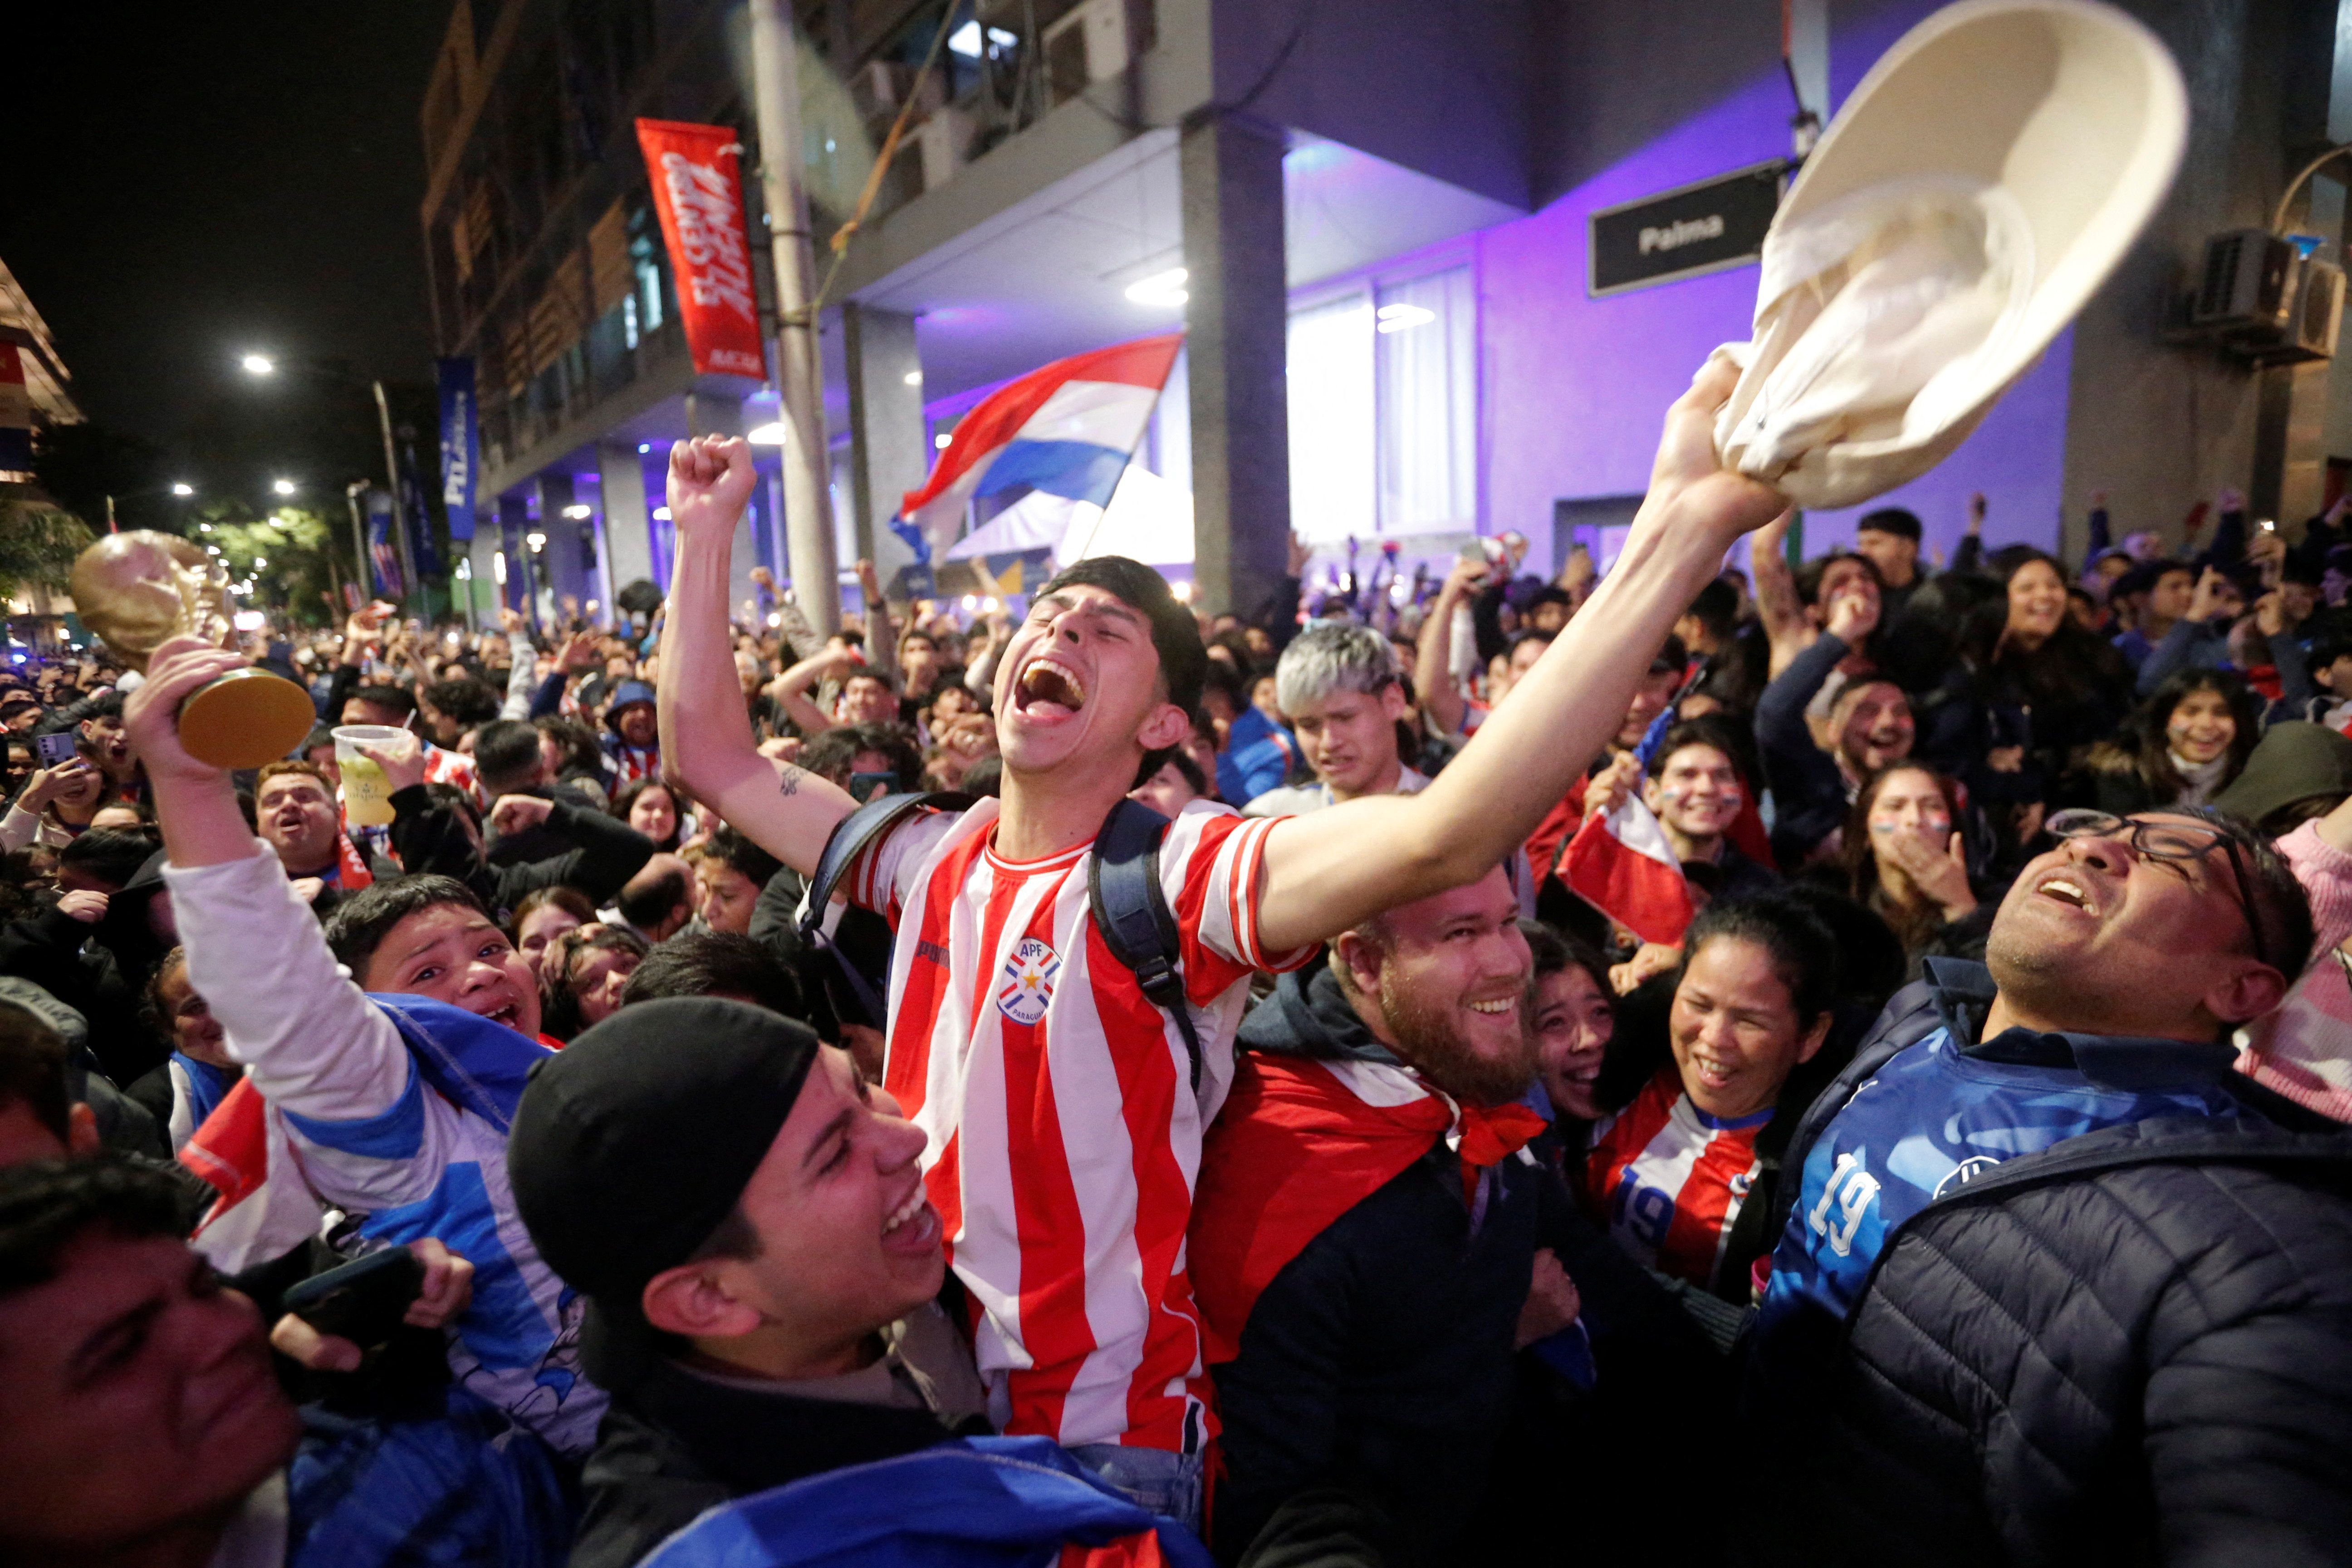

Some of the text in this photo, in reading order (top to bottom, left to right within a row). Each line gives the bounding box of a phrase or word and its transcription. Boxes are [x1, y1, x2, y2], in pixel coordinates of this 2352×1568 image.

[1639, 214, 1723, 256] Palma
[1020, 944, 1042, 957] APF
[1012, 1009, 1044, 1021] PARAGUAY
[1809, 1152, 1881, 1257] 19
